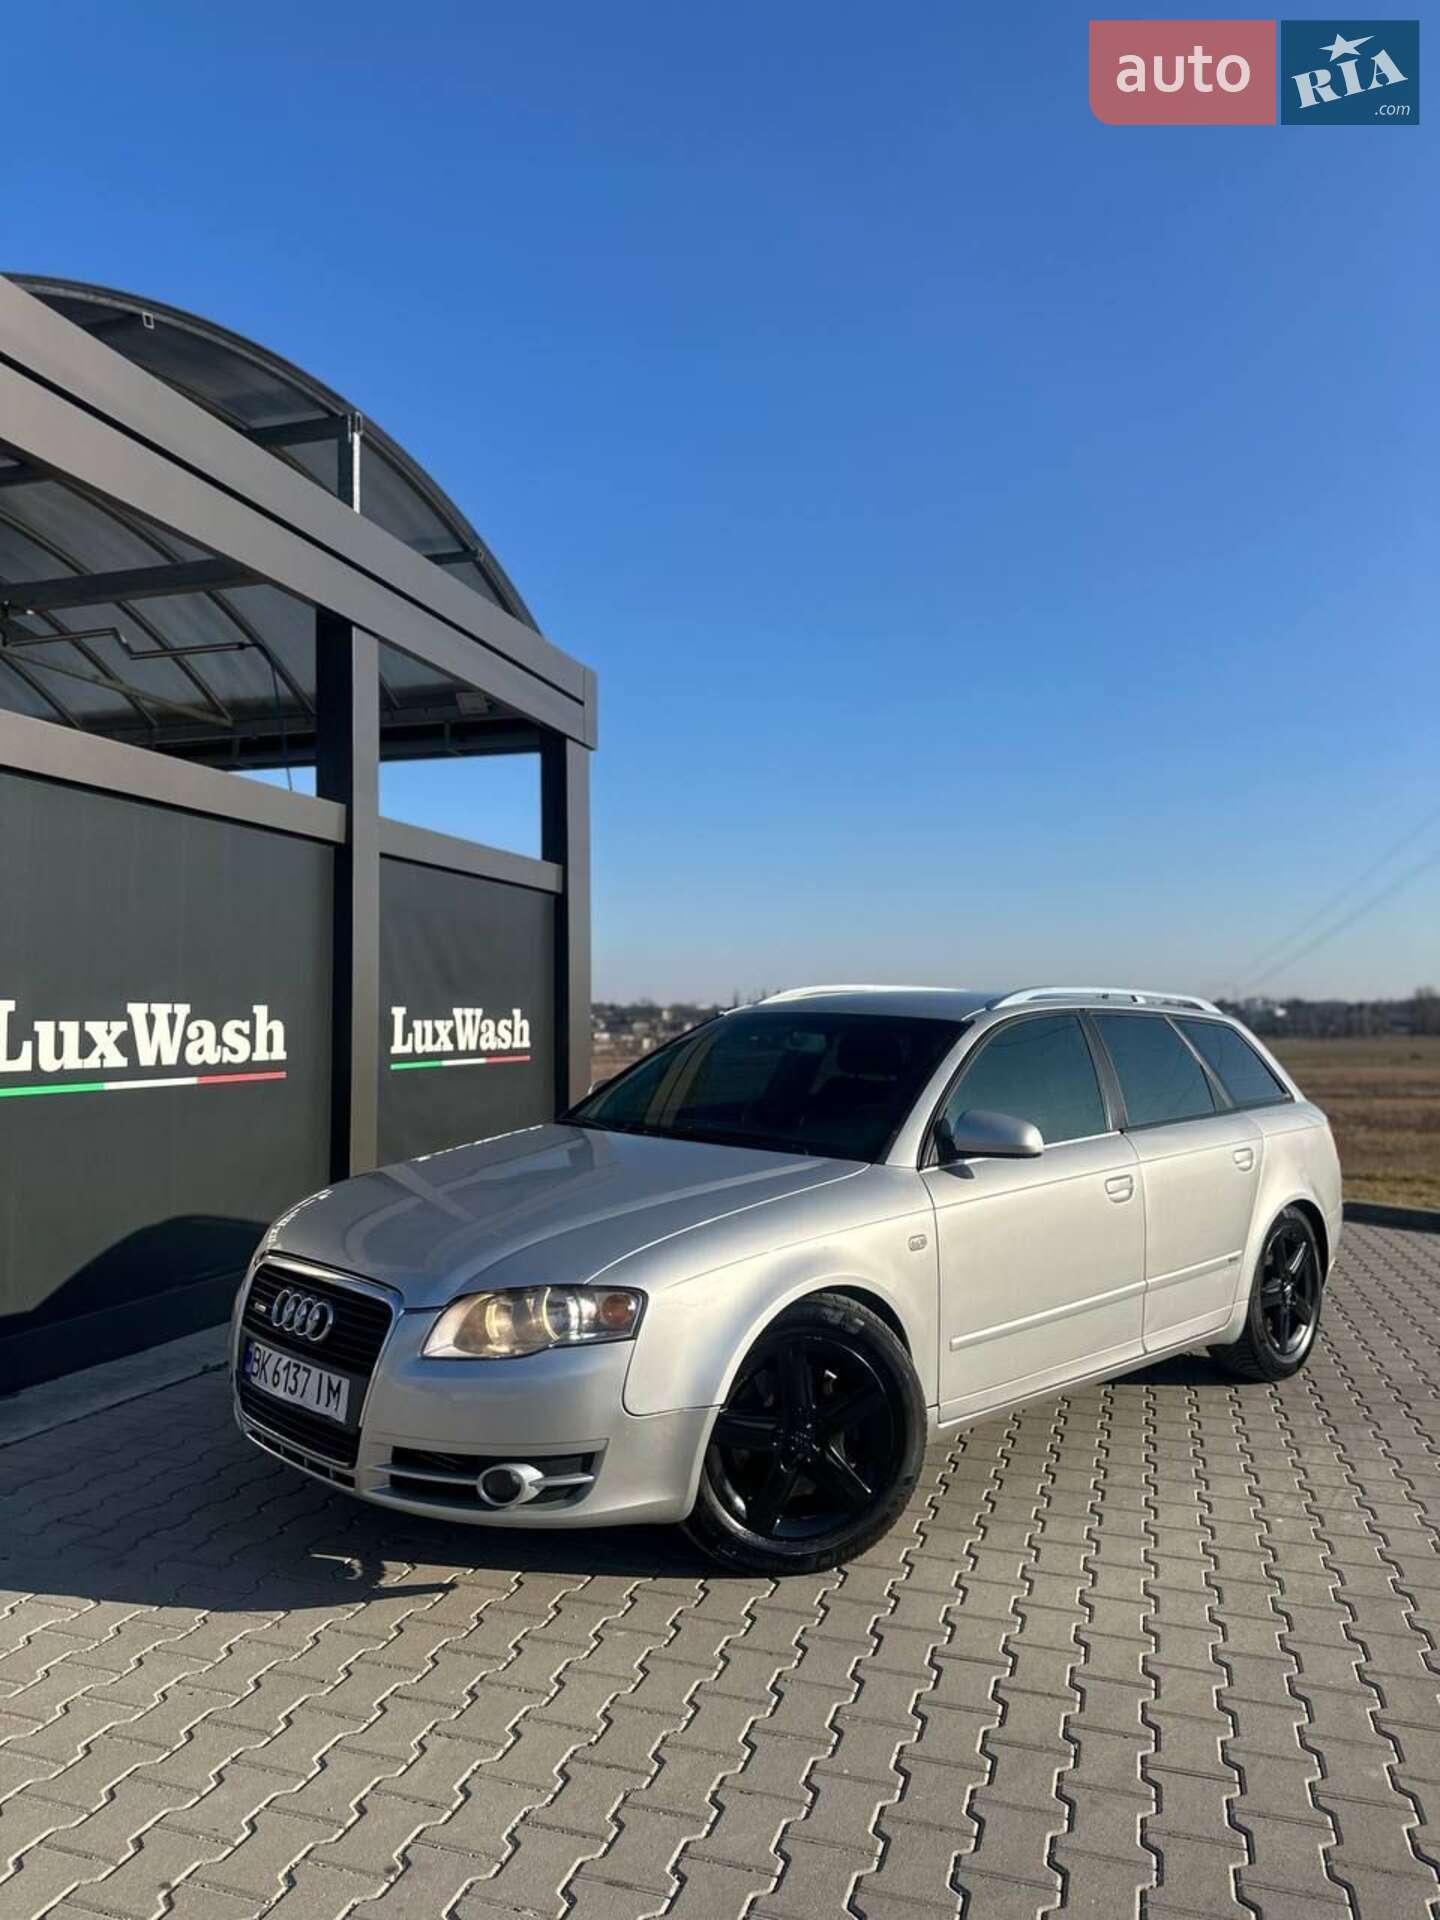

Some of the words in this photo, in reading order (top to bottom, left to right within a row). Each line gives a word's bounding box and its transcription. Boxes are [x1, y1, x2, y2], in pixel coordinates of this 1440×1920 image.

[0, 999, 287, 1073] LuxWash
[390, 1006, 531, 1054] LuxWash
[251, 1347, 272, 1384] BK
[272, 1358, 312, 1398] 6137
[316, 1372, 342, 1412] IM
